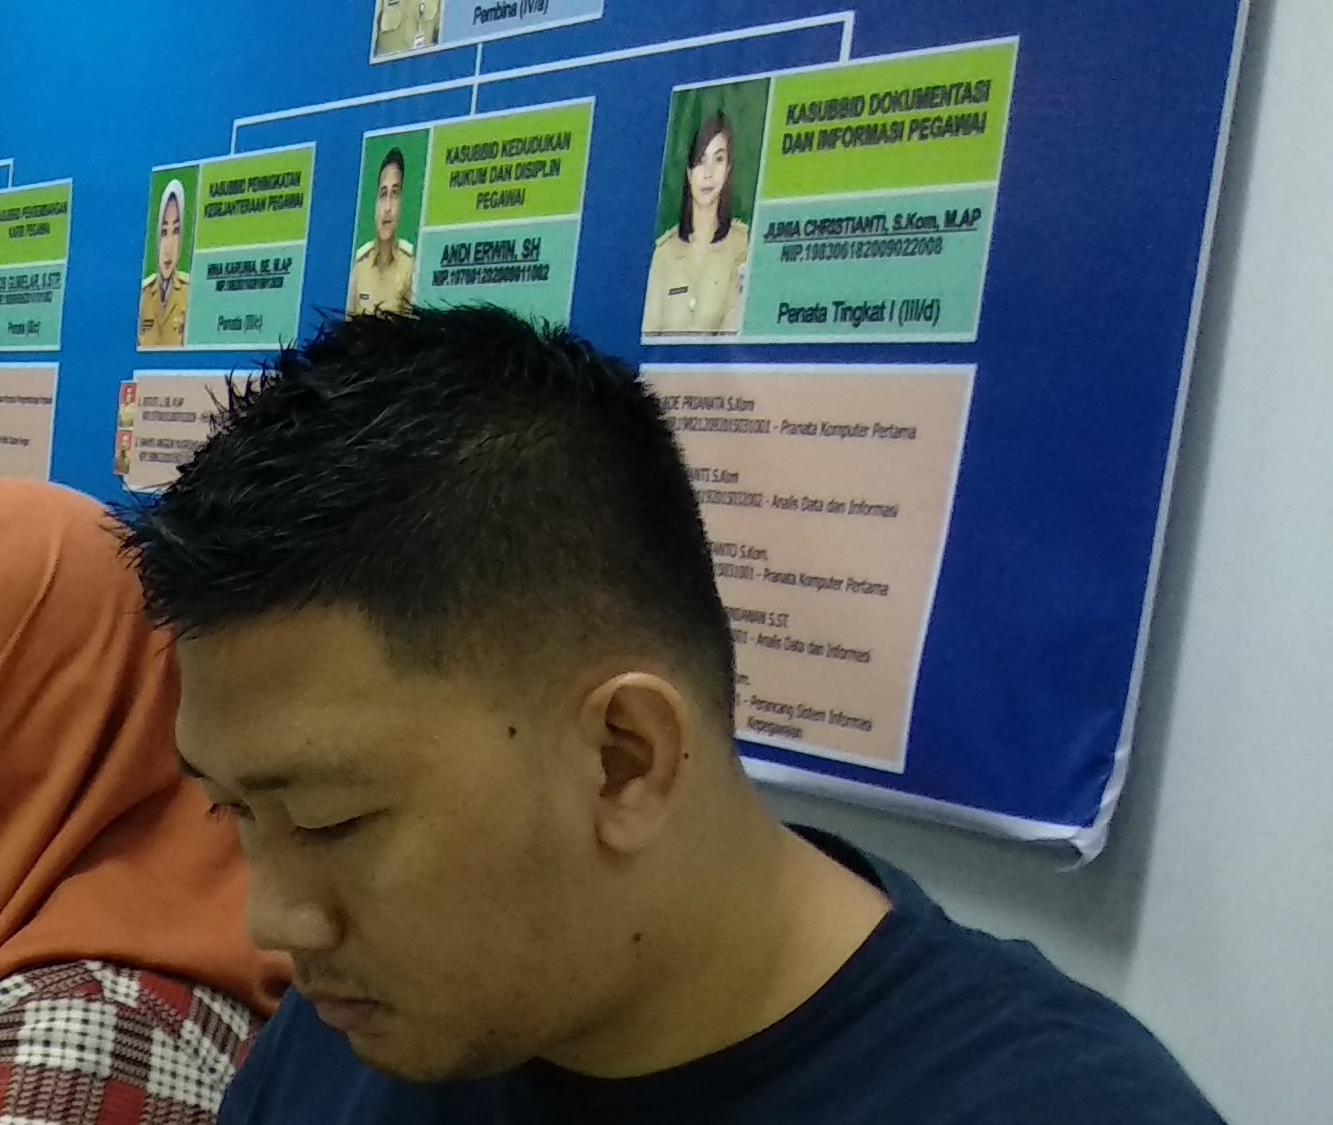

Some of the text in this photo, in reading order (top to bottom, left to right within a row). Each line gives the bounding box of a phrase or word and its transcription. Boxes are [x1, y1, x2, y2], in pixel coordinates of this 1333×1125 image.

[473, 4, 516, 25] Pembina
[786, 80, 991, 125] KASUBBID DOKUMENTASI
[782, 112, 987, 155] DAN INFORMASI PEGAWAI
[445, 132, 571, 165] KASUBBID KEDUDUKAN
[449, 158, 561, 188] HUKUM DAN DISIPLIN
[476, 188, 526, 210] PEGAWAI
[892, 212, 939, 233] S.Kom,
[440, 243, 473, 265] ANDI
[522, 237, 541, 261] SH
[777, 303, 827, 325] Penata
[832, 300, 887, 328] Tingkat
[780, 419, 817, 436] Pranata
[820, 421, 869, 440] Komputer
[872, 423, 917, 440] Pertama
[801, 496, 823, 513] Data
[826, 498, 845, 514] dan
[848, 500, 899, 518] Informasi
[763, 567, 796, 586] Pranata
[799, 573, 844, 592] Komputer
[845, 577, 889, 597] Pertama
